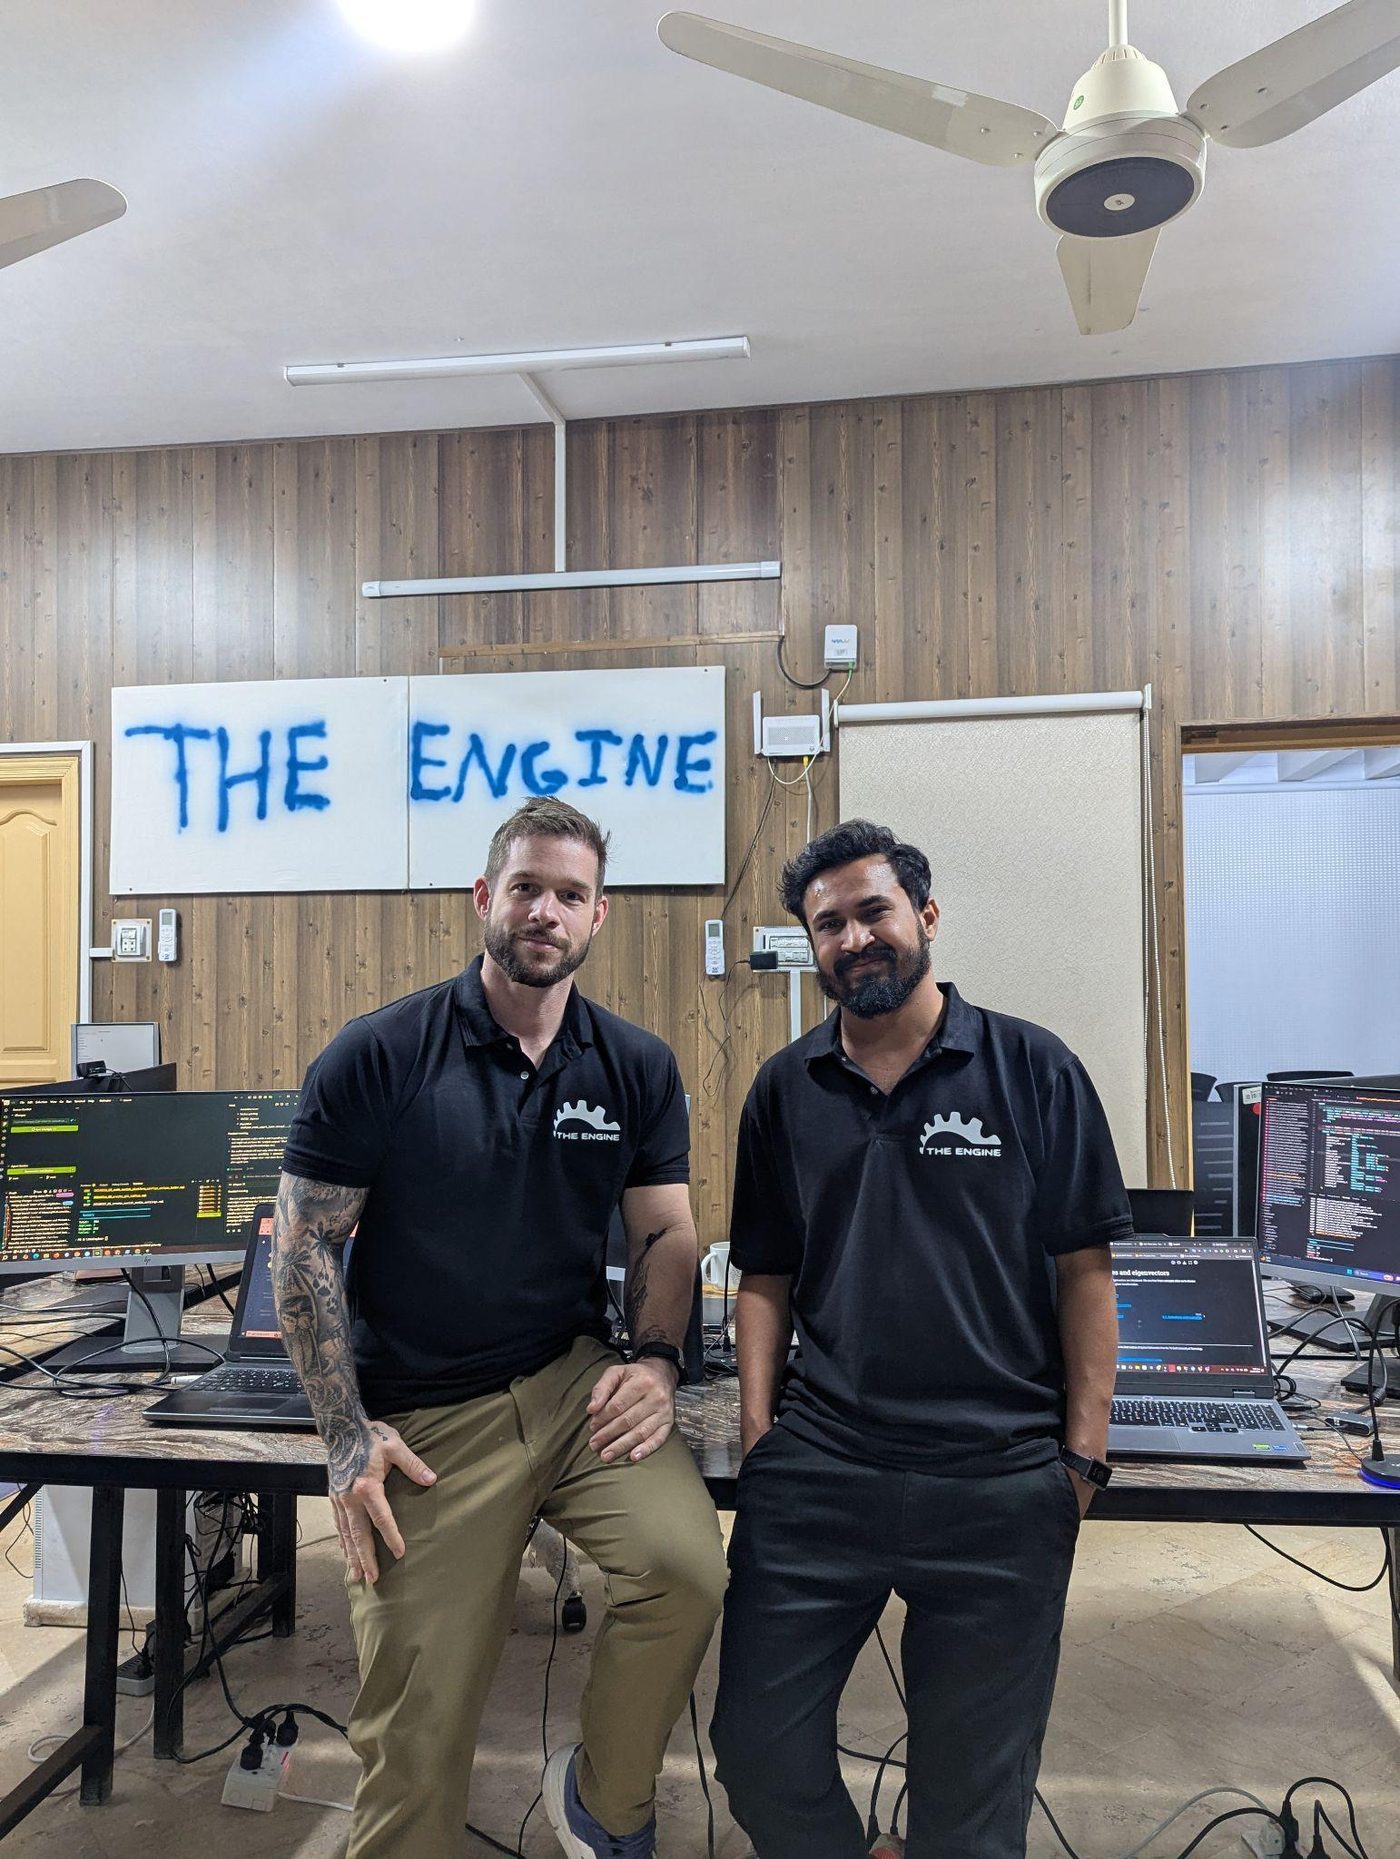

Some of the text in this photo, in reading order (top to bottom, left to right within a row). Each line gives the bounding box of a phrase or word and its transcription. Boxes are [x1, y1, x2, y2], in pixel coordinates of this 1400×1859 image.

[124, 719, 718, 833] THE ENGINE
[557, 1131, 620, 1141] THE ENGINE
[926, 1147, 1002, 1157] THE ENGINE
